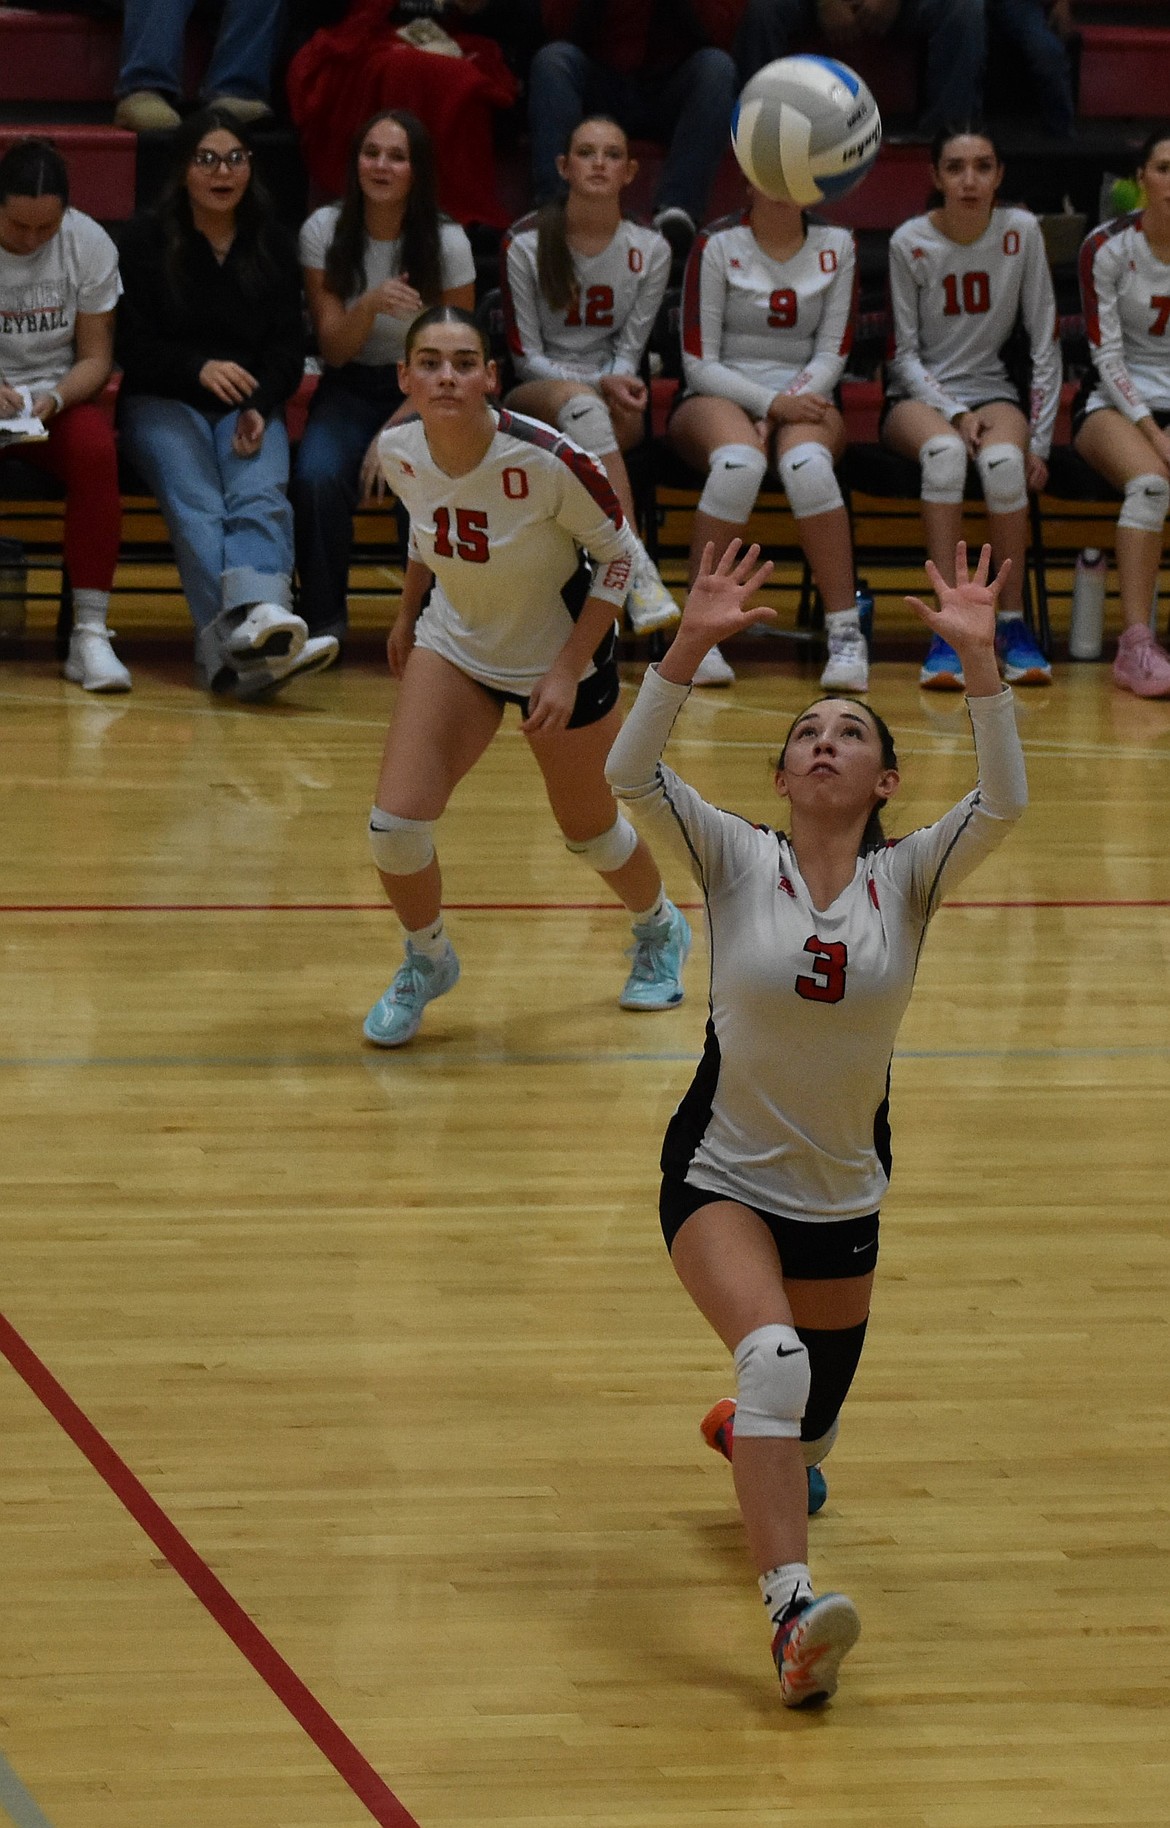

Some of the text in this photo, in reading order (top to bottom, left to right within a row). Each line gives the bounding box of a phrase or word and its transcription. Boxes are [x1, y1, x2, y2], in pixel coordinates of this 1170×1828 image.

[564, 285, 614, 328] 12
[767, 288, 798, 329] 9
[942, 271, 991, 317] 10
[1148, 295, 1170, 337] 7
[502, 467, 529, 499] O
[433, 507, 490, 563] 15
[795, 934, 848, 1004] 3
